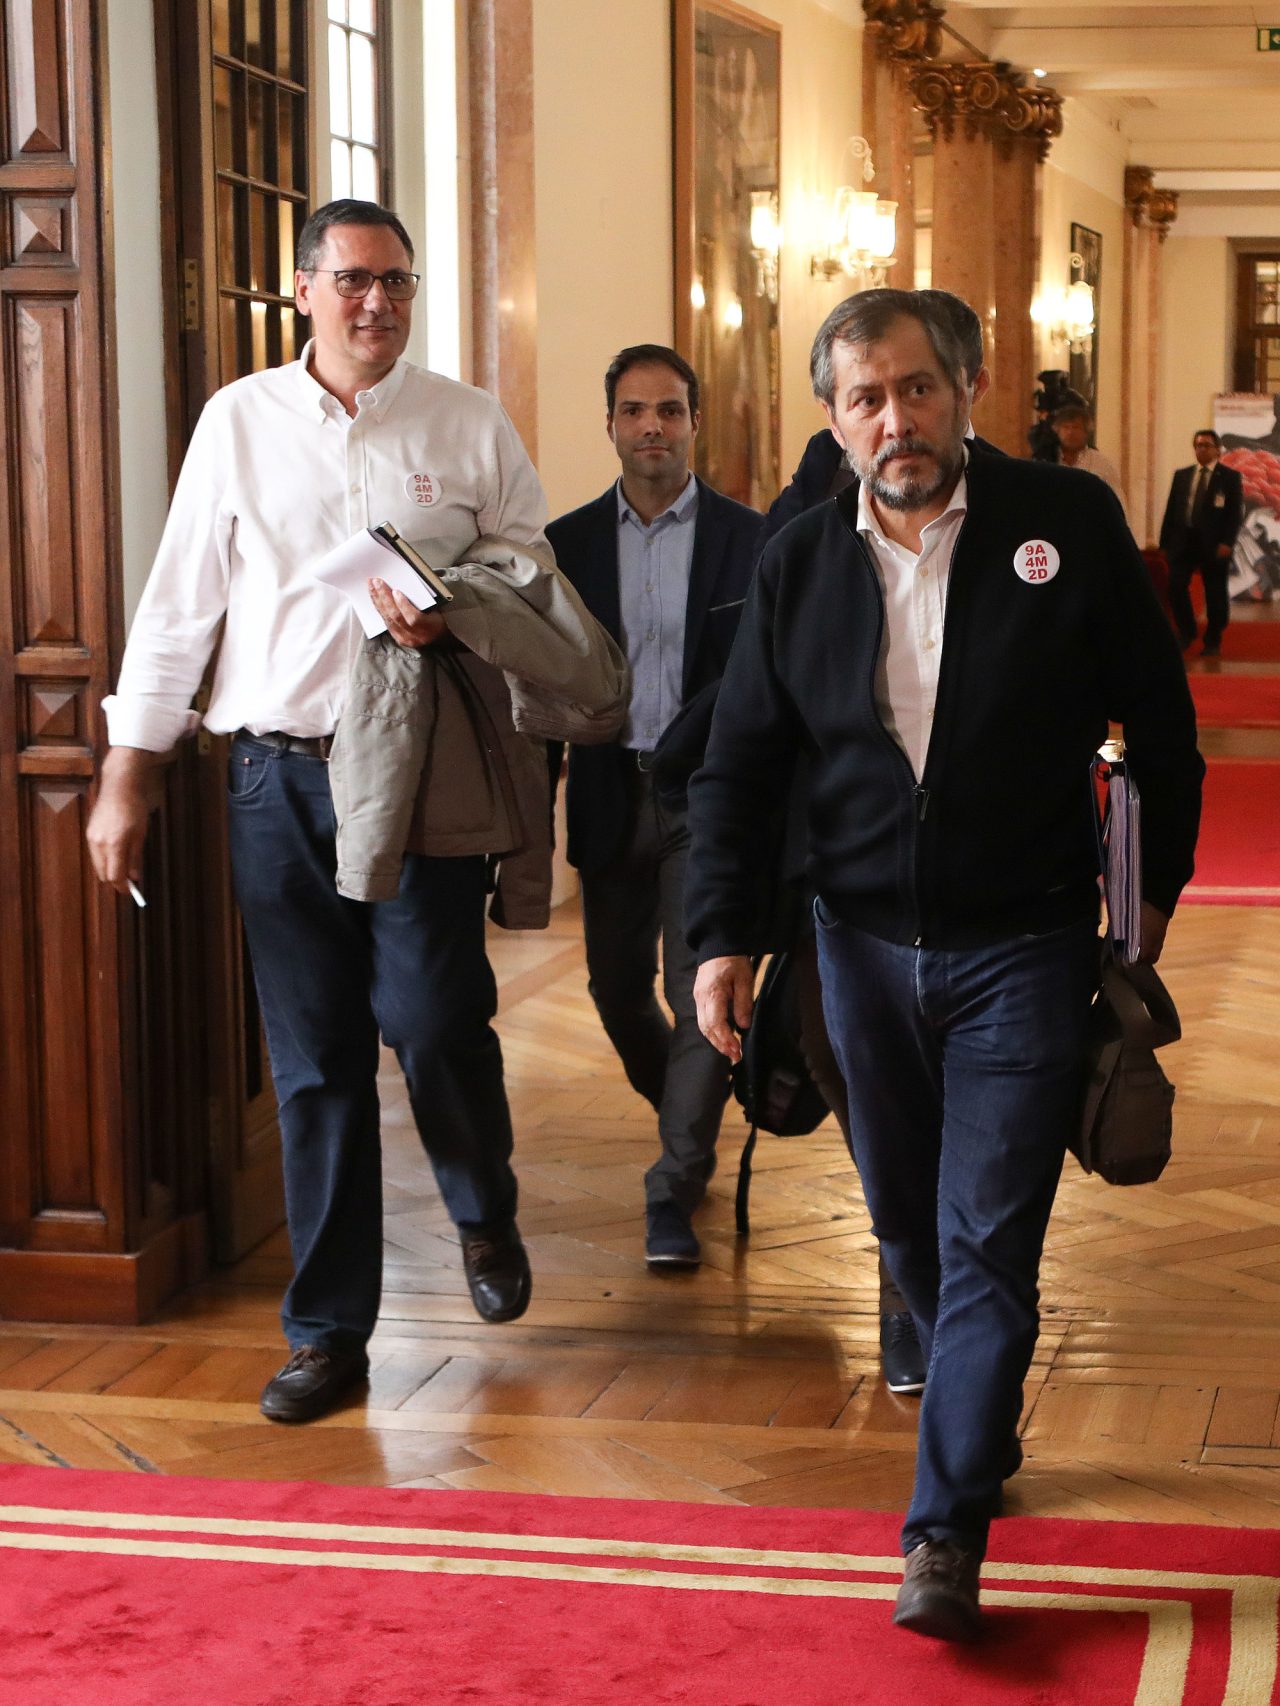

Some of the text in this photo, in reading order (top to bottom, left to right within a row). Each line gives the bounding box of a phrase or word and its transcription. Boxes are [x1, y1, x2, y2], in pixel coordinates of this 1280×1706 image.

[414, 474, 431, 483] 9A
[415, 485, 433, 493] 4M
[417, 494, 433, 503] 2D
[1025, 544, 1046, 556] 9A
[1025, 556, 1048, 567] 4M
[1028, 568, 1048, 580] 2D
